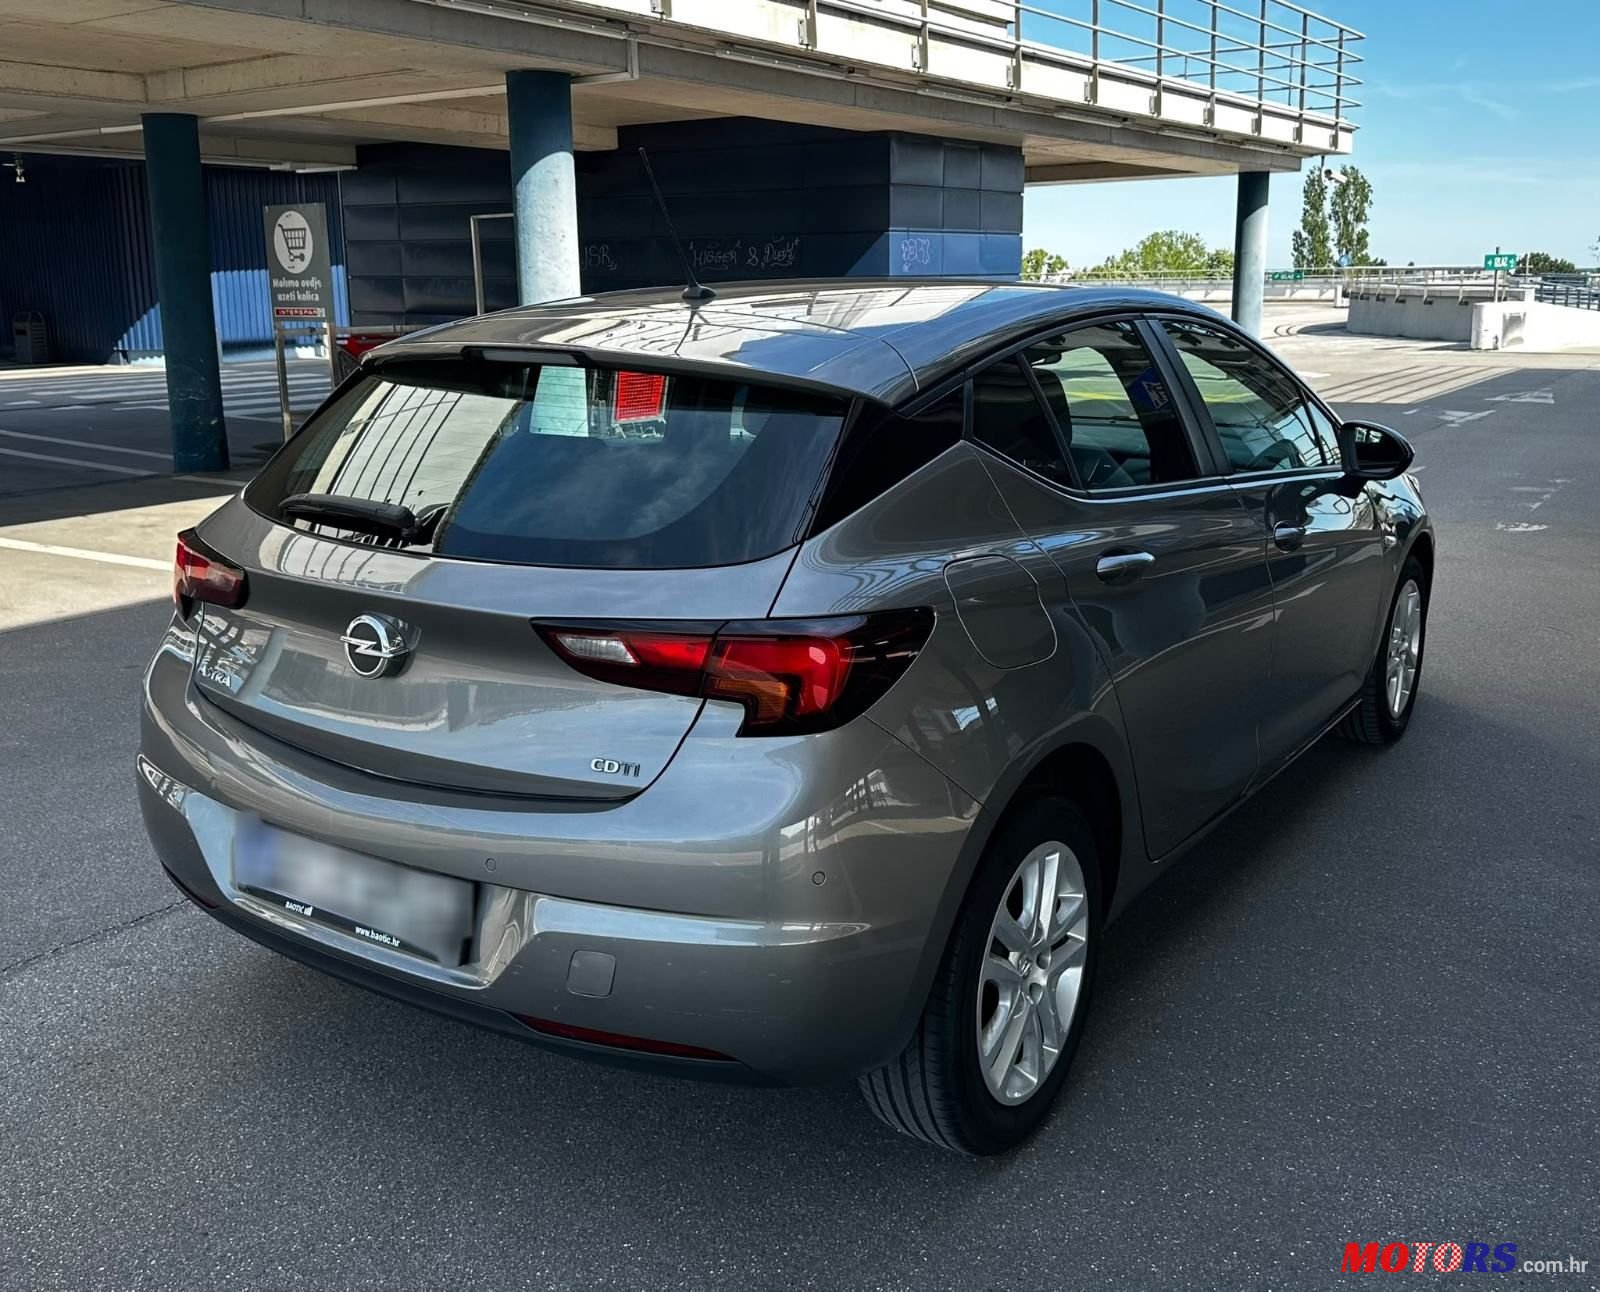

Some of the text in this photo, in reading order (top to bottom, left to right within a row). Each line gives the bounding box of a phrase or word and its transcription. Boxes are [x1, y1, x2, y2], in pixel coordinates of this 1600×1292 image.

[296, 290, 320, 302] kolica
[590, 758, 641, 778] CDTI
[355, 926, 401, 947] www.baotic.hr
